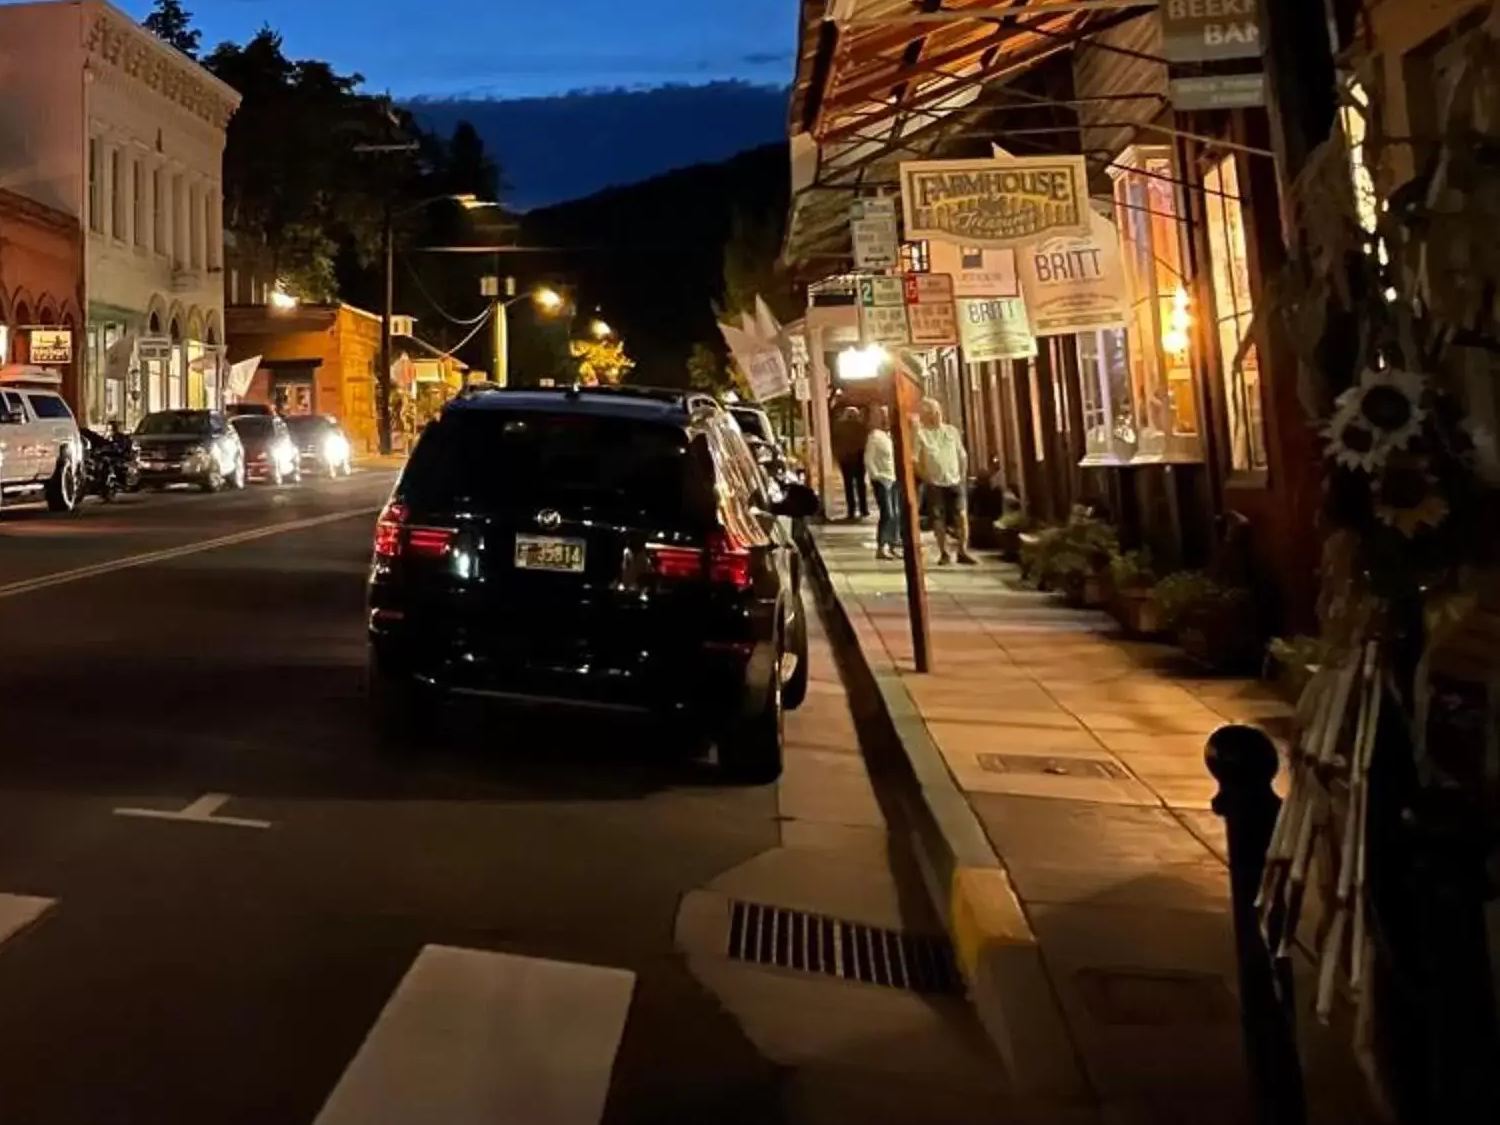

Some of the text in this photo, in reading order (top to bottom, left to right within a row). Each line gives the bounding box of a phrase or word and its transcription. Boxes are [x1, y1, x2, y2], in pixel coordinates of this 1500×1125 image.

[919, 171, 1070, 206] FARMHOUSE
[1034, 248, 1102, 283] BRITT
[861, 281, 873, 303] 2
[968, 300, 1014, 324] BRITT
